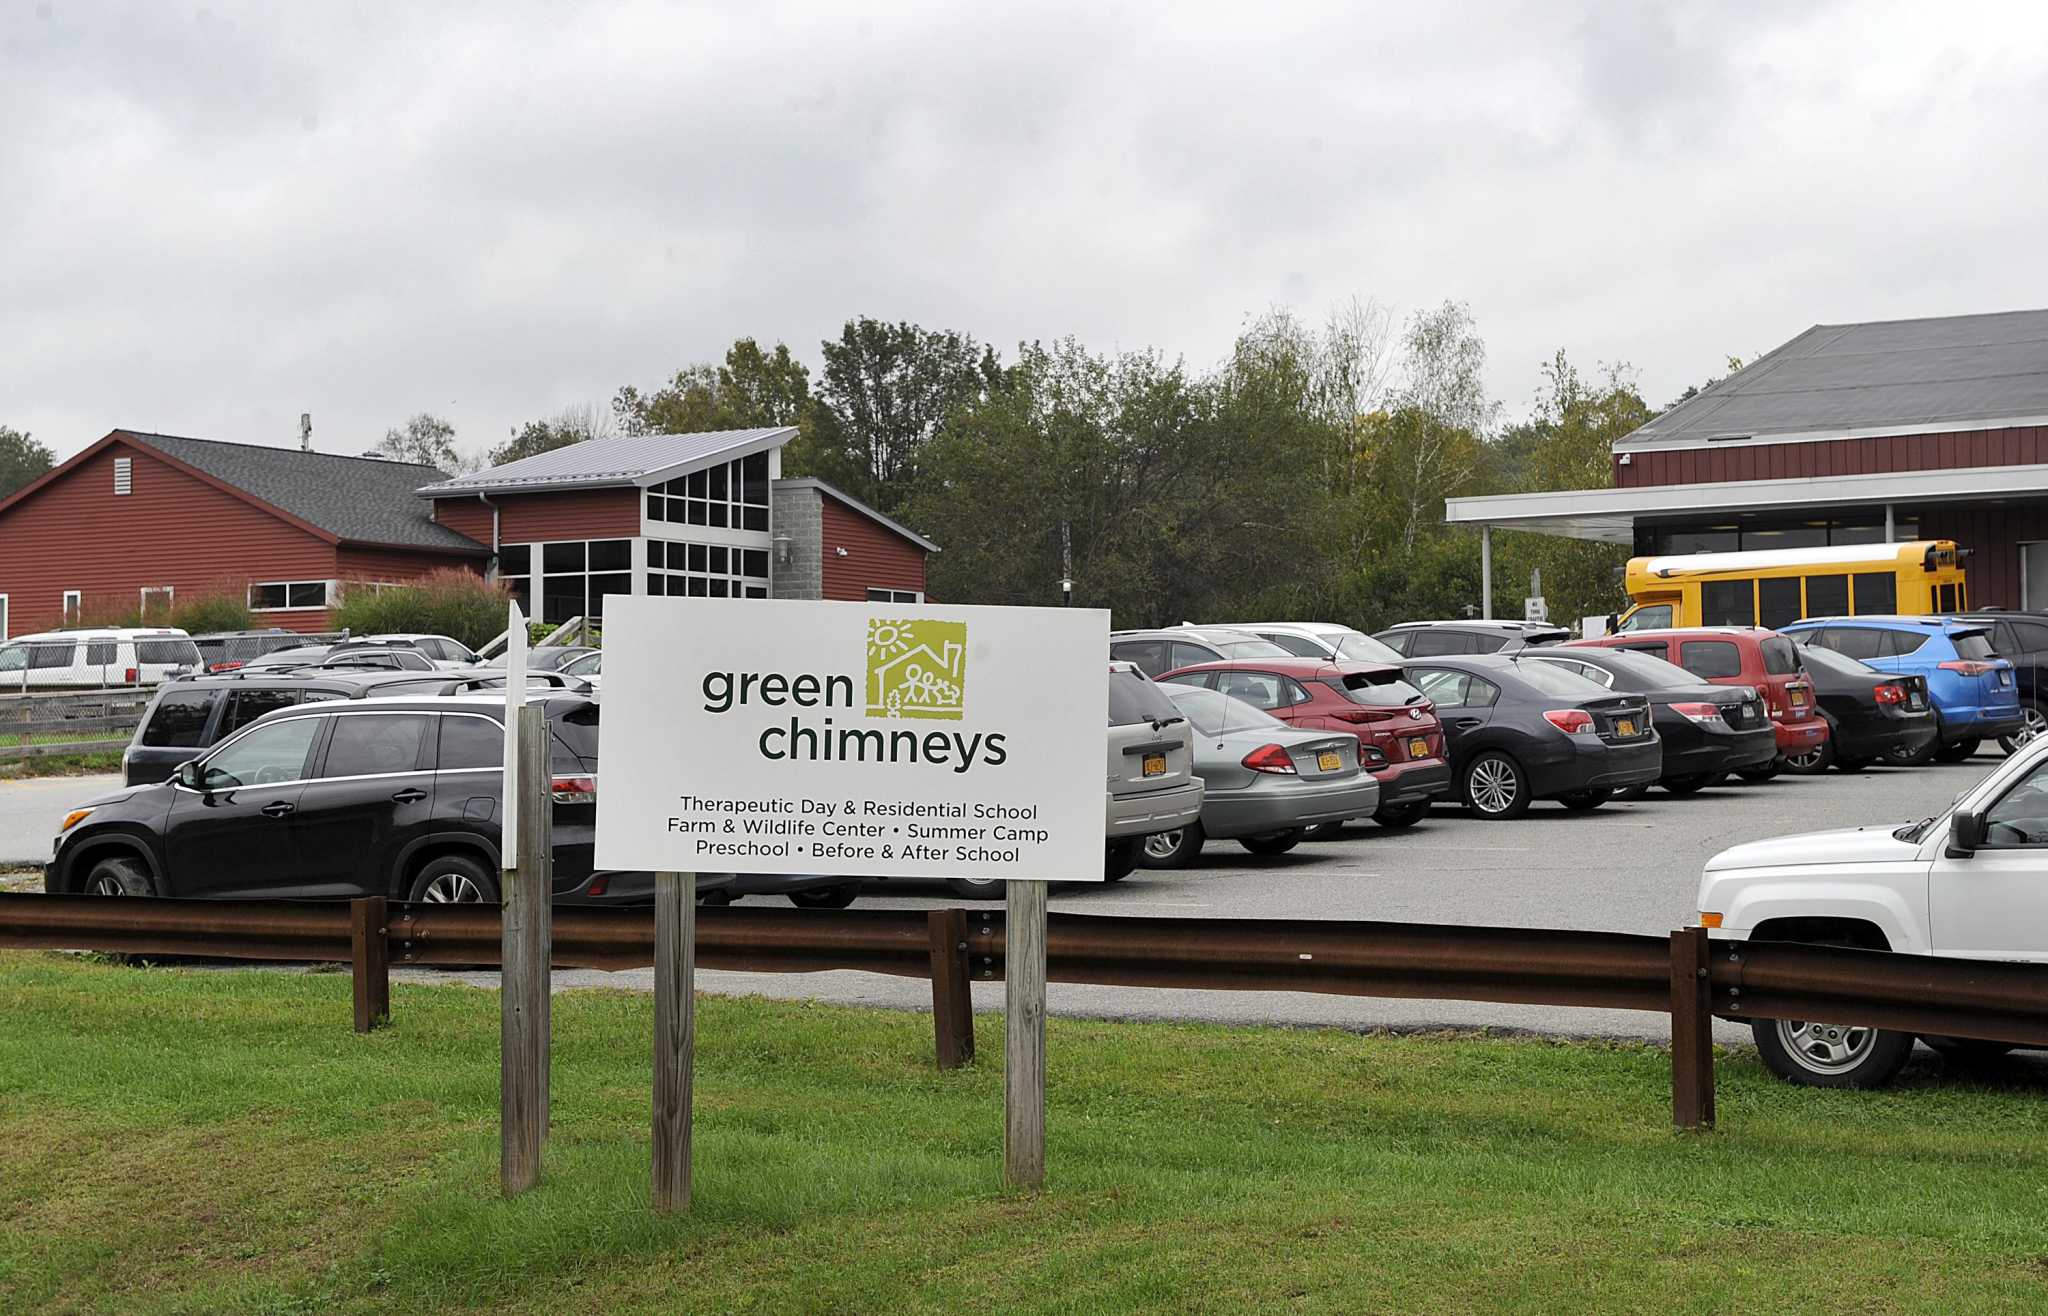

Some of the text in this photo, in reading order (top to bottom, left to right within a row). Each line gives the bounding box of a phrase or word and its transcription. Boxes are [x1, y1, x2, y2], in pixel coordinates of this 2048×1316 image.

[702, 671, 853, 714] green
[759, 716, 1007, 774] chimneys
[679, 795, 1037, 820] Therapeutic Day & Residential School
[668, 817, 1049, 845] Farm & Wildlife Center Summer Camp
[696, 839, 1019, 862] Preschool Before & After School
